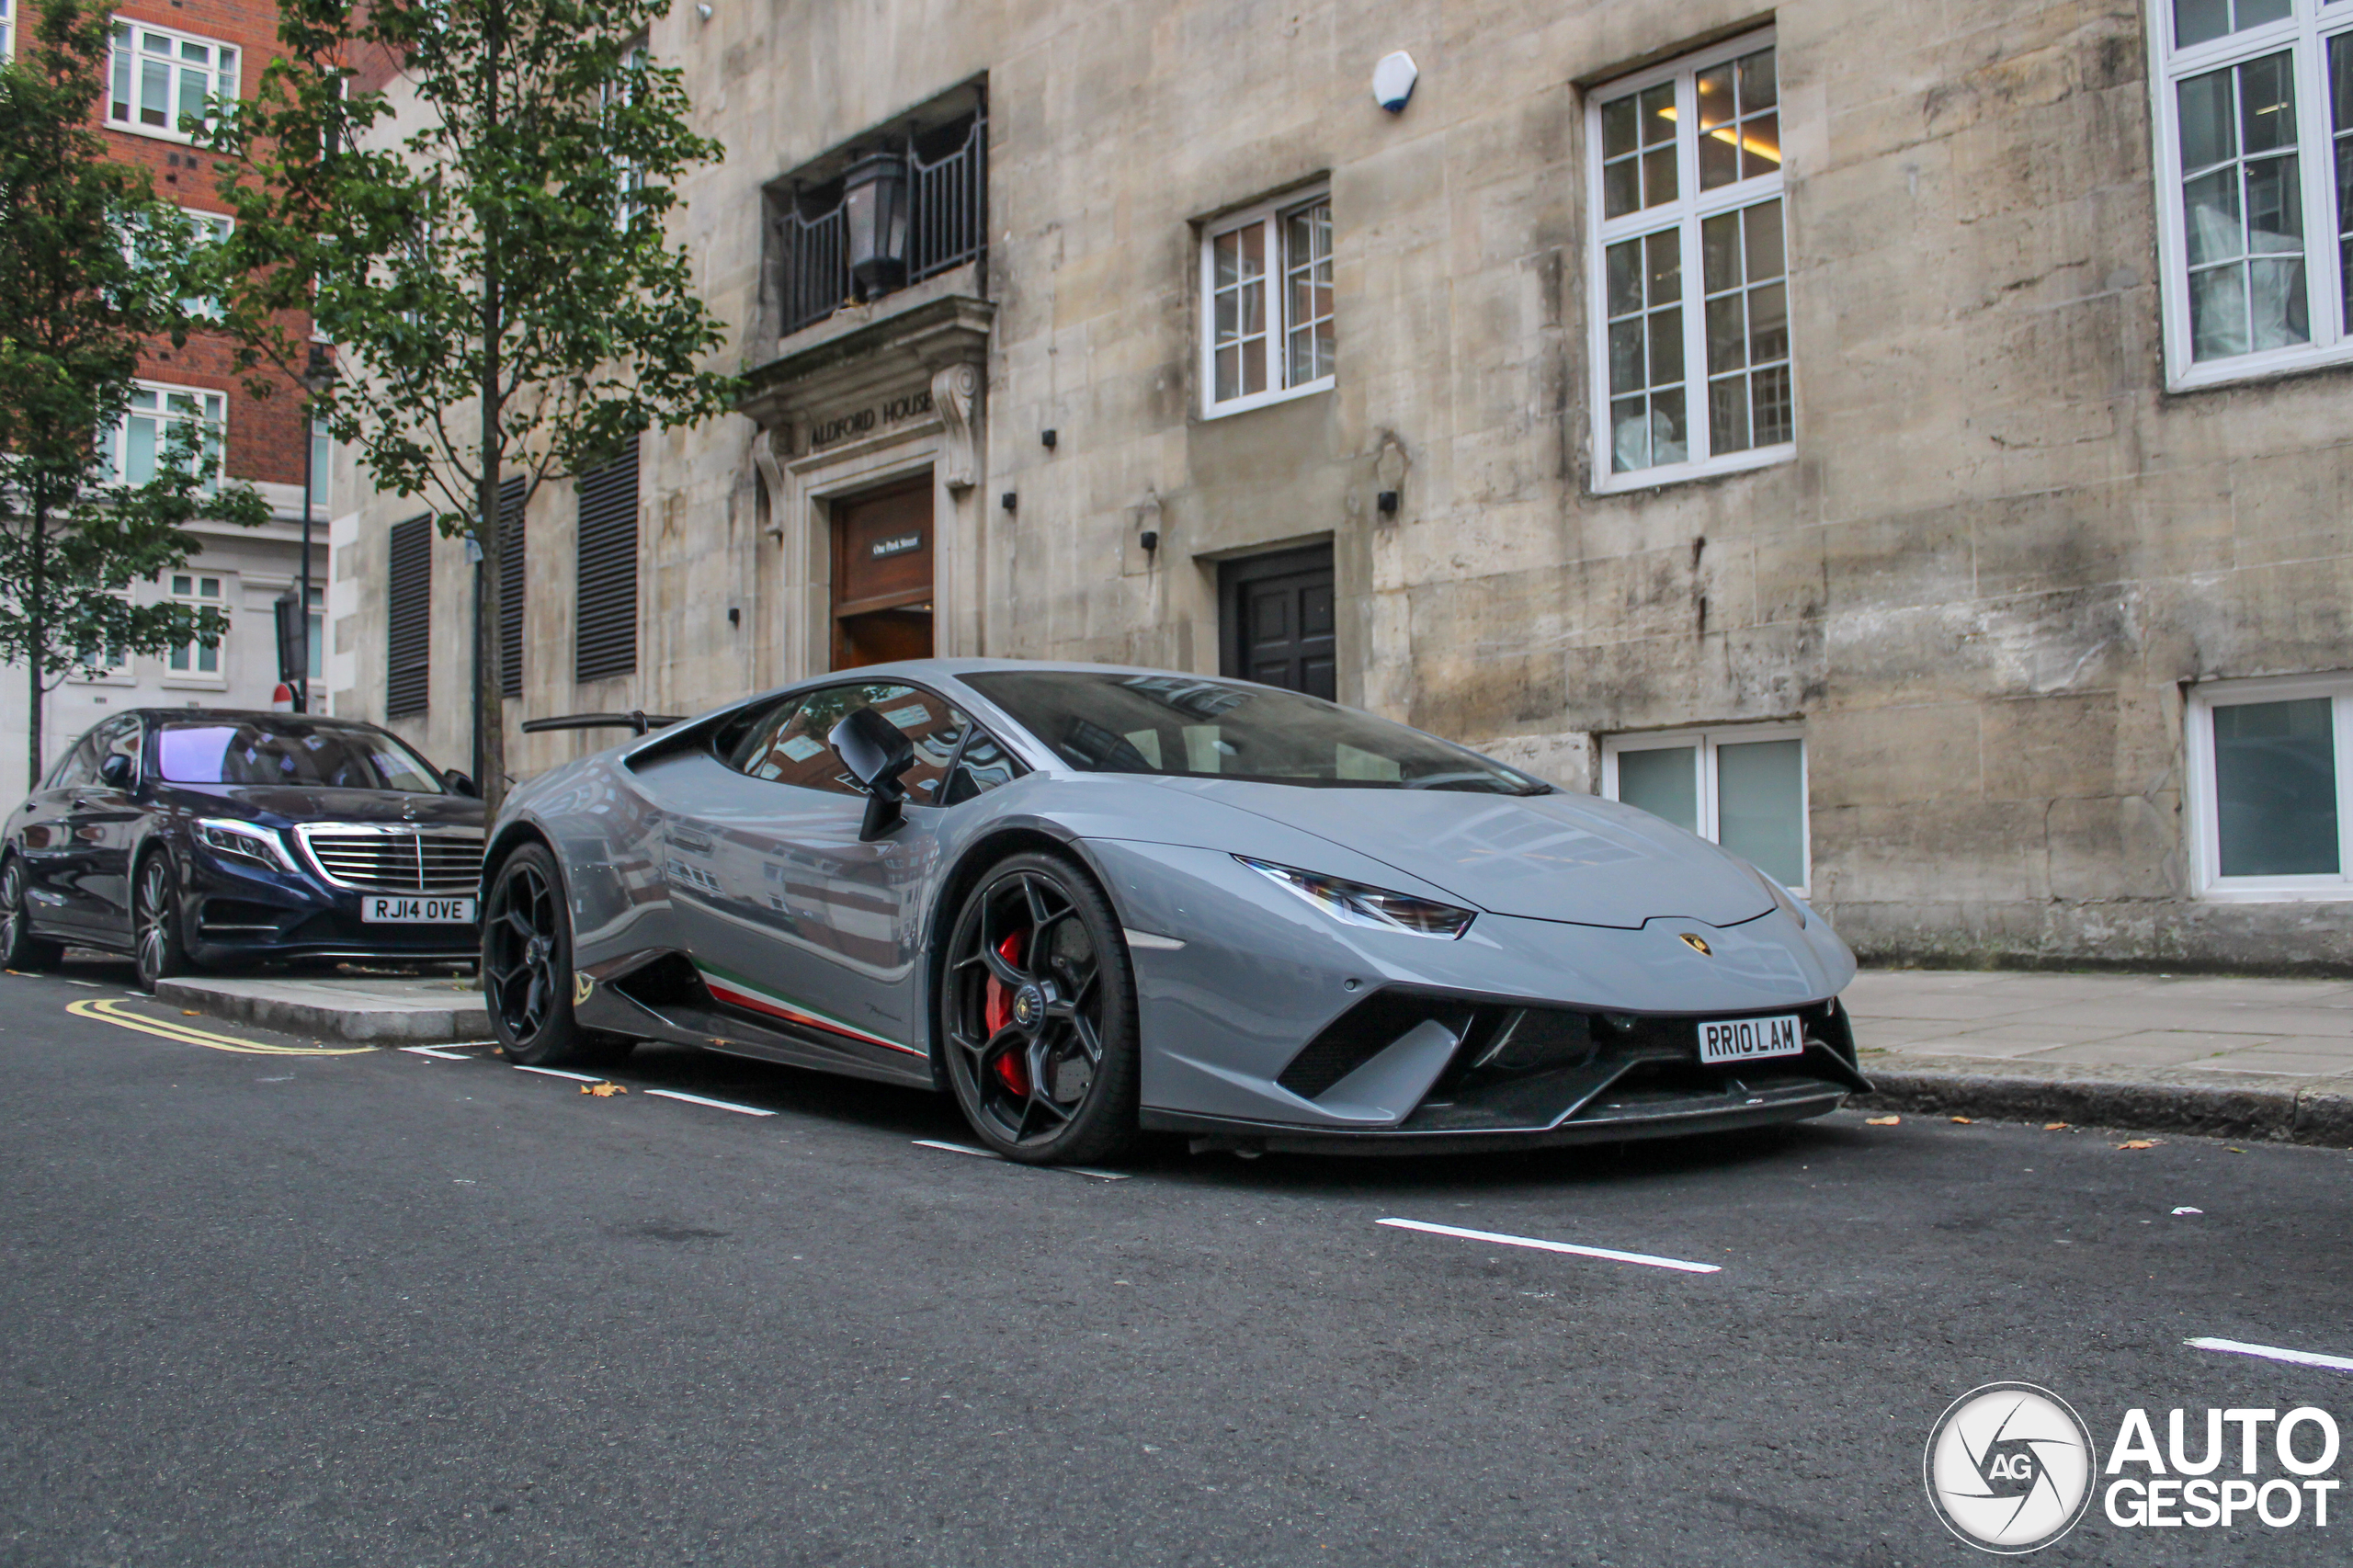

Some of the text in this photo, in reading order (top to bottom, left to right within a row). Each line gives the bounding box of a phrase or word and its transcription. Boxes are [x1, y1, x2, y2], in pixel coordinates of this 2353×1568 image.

[812, 390, 933, 447] ALDFORD HOUSE
[376, 900, 463, 919] RJ14 OVE
[1756, 1019, 1795, 1052] LAM
